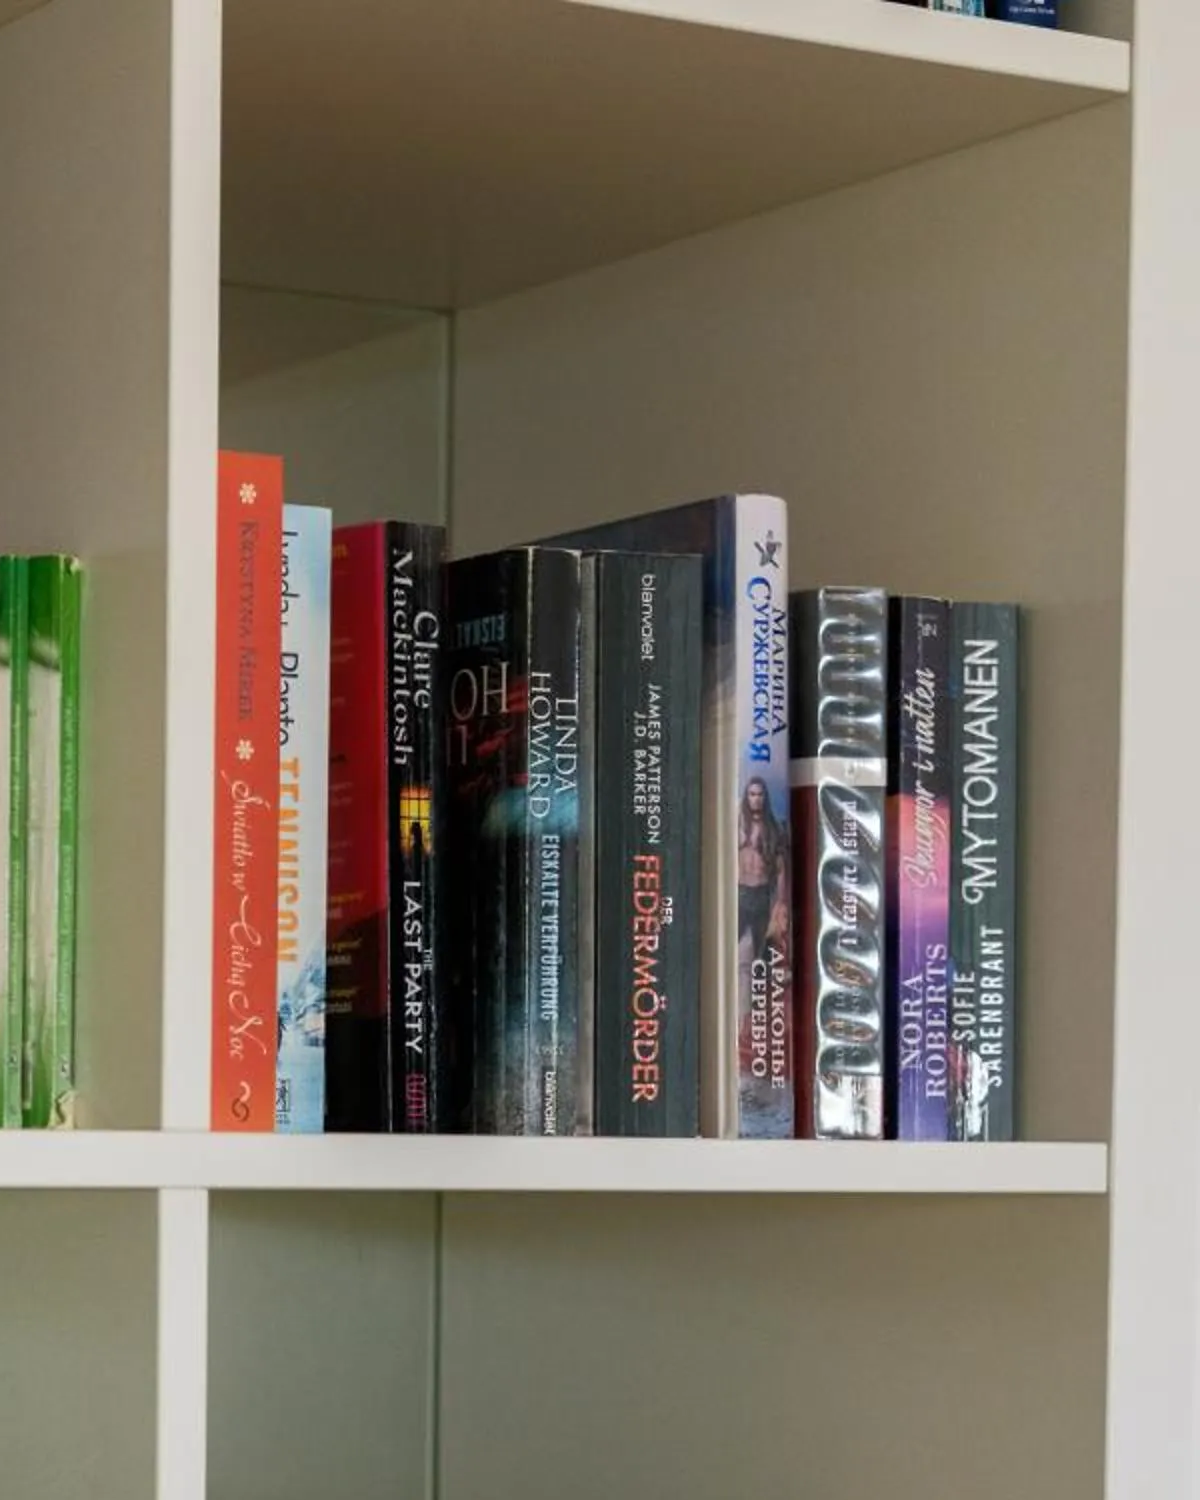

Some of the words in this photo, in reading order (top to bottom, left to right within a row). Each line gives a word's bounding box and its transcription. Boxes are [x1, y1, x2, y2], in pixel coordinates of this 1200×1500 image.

[238, 520, 260, 638] KRYSTYNA
[639, 574, 657, 661] blanvalet
[392, 549, 413, 765] Mackintosh
[413, 610, 440, 709] Clare
[746, 576, 772, 763] СУРЖЕВСКАЯ
[771, 606, 787, 736] МАРИНА
[529, 671, 552, 819] HOWARD
[555, 695, 578, 795] LINDA
[633, 711, 647, 743] J.D.
[647, 683, 662, 740] JAMES
[905, 667, 936, 752] natten
[633, 749, 648, 815] BARKER
[646, 745, 663, 844] PATTERSON
[961, 639, 999, 905] MYTOMANEN
[403, 881, 422, 951] LAST
[541, 833, 559, 908] EISKALTE
[660, 897, 673, 925] DER
[403, 962, 422, 1054] PARTY
[423, 948, 433, 971] THE
[540, 913, 563, 1021] VERFÜHRUNG
[631, 854, 667, 1102] FEDERMÖRDER
[952, 970, 977, 1042] SOFIE
[979, 924, 1005, 1088] SARENBRANT
[751, 958, 767, 1079] СЕРЕБРО
[767, 946, 785, 1090] ДРАКОНЬЕ
[900, 972, 923, 1071] NORA
[924, 942, 948, 1098] ROBERTS
[542, 1070, 558, 1135] blanvalet
